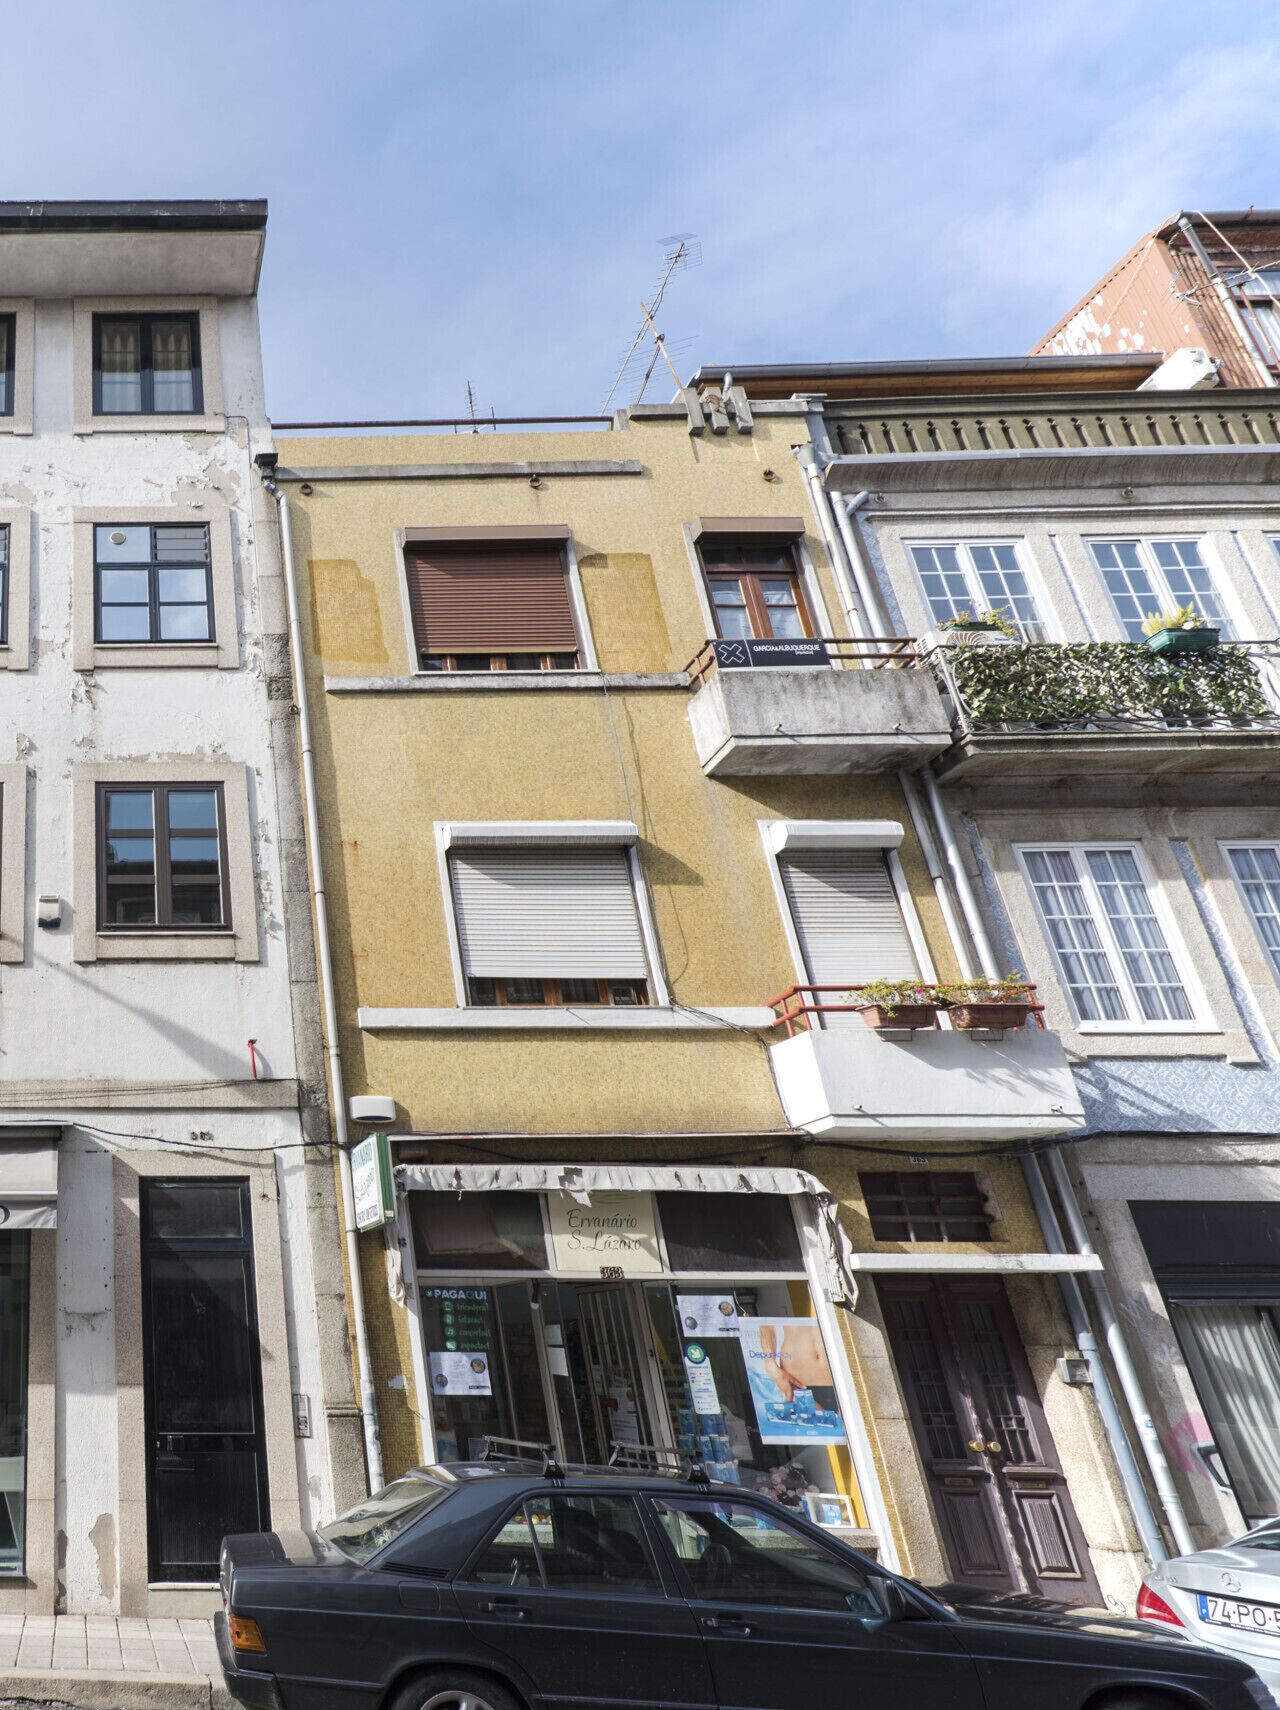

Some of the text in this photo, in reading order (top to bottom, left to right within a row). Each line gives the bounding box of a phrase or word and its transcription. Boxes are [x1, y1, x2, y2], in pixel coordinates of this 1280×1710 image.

[566, 1208, 638, 1228] Ervanário
[600, 1266, 625, 1280] 363
[433, 1289, 488, 1300] PAGAQUI
